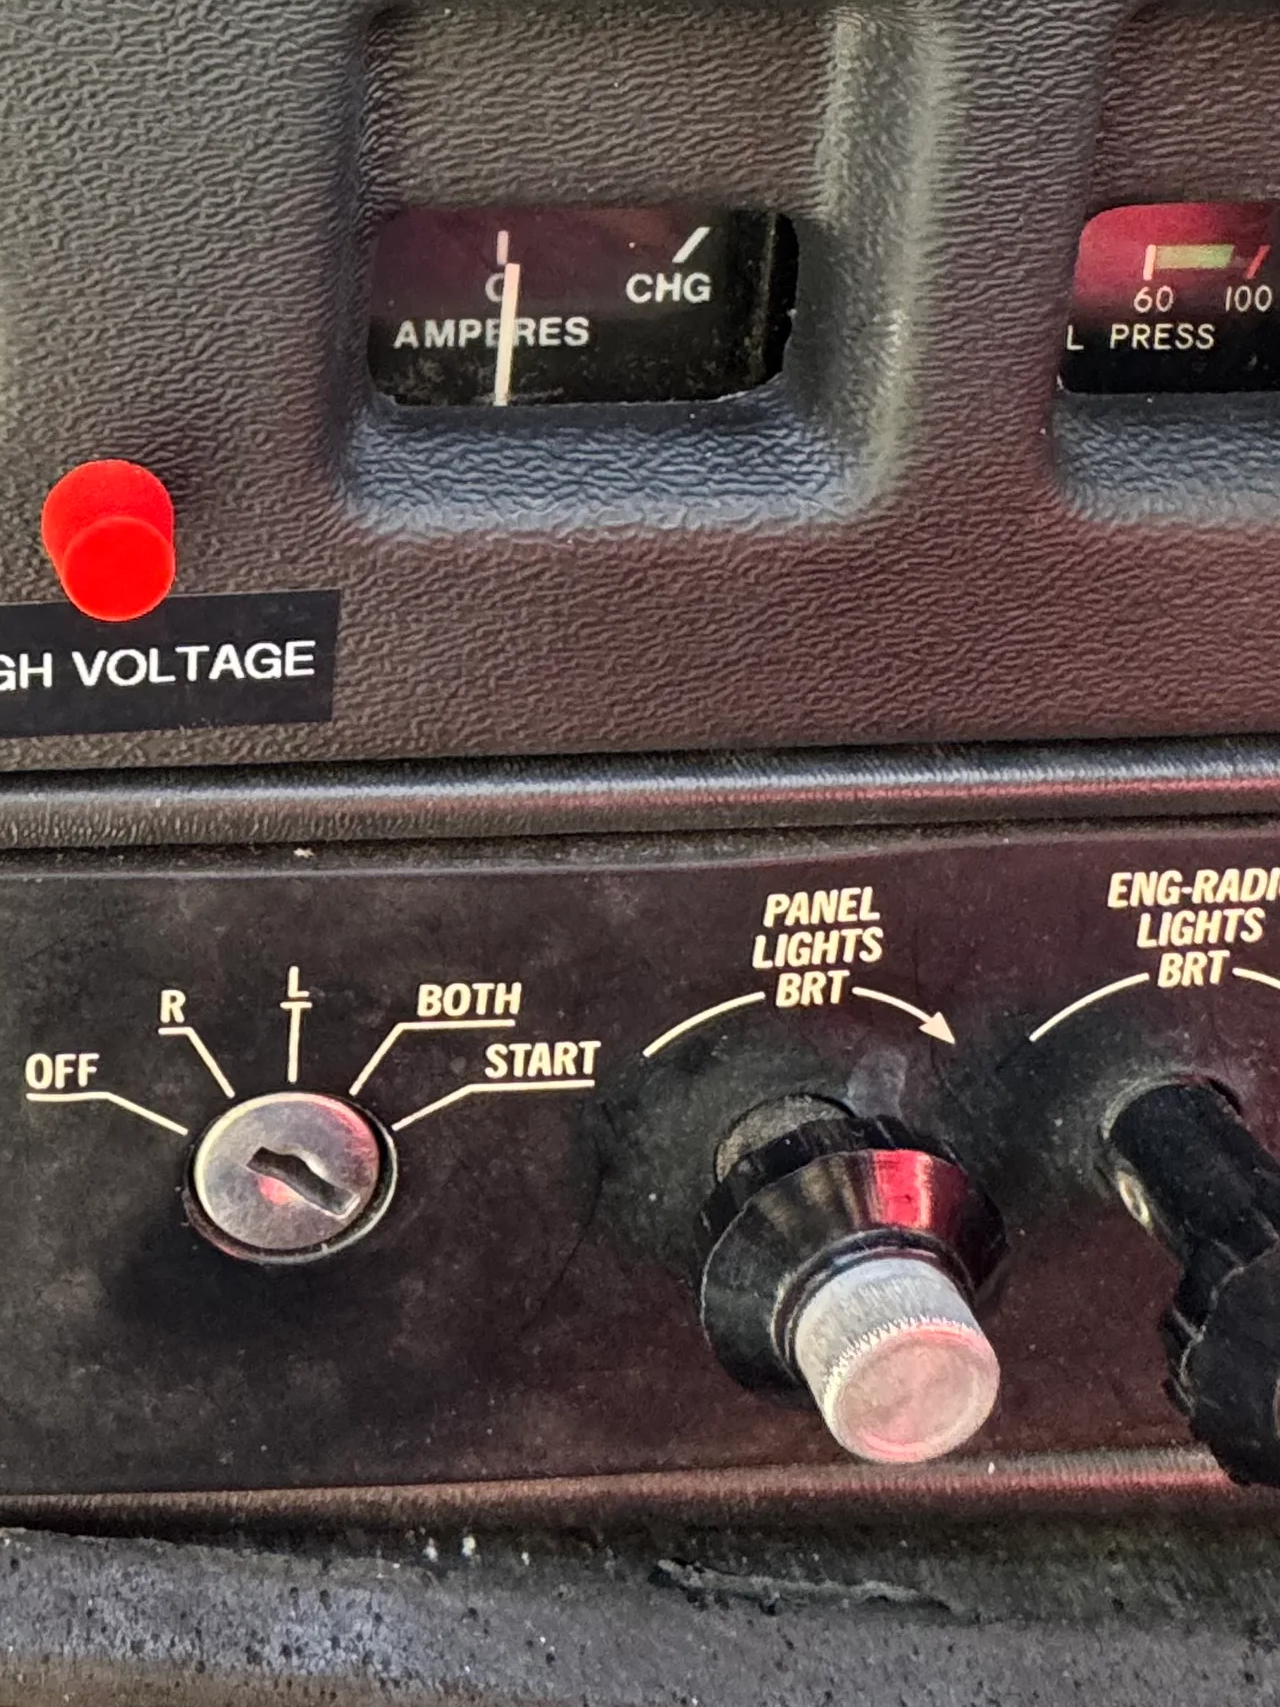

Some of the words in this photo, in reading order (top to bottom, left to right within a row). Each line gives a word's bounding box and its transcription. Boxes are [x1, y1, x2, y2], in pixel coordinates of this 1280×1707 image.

[625, 272, 713, 304] CHG
[1133, 284, 1174, 314] 60
[1225, 284, 1273, 313] 100
[393, 316, 590, 350] AMPERES
[1109, 323, 1216, 351] PRESS
[71, 640, 317, 687] VOLTAGE
[762, 886, 882, 928] PANEL
[1106, 867, 1280, 909] ENG-RADI
[1136, 907, 1266, 949] LIGHTS
[751, 927, 885, 970] LIGHTS
[288, 966, 310, 998] L
[1157, 949, 1231, 988] BRT
[161, 990, 186, 1025] R
[417, 982, 523, 1018] BOTH
[775, 969, 851, 1008] BRT
[25, 1052, 100, 1091] OFF
[485, 1040, 602, 1079] START
